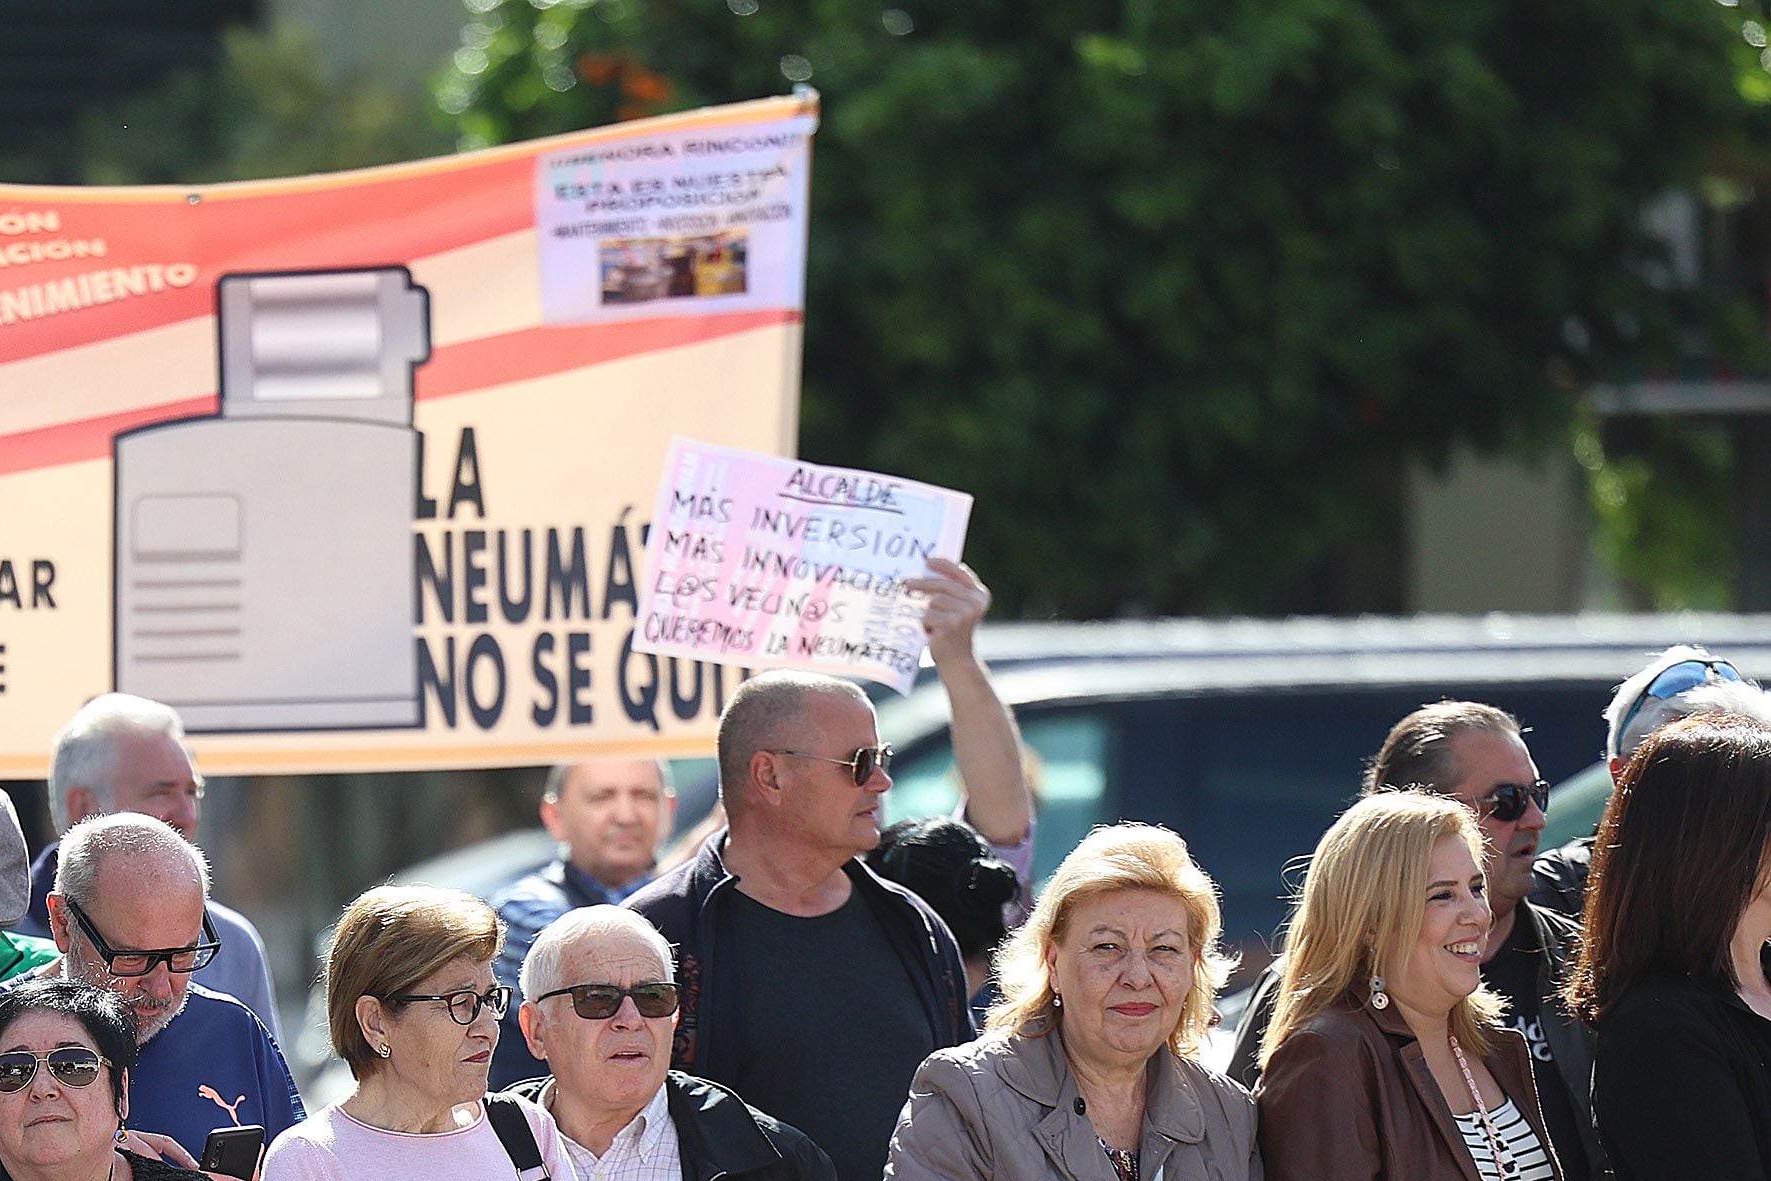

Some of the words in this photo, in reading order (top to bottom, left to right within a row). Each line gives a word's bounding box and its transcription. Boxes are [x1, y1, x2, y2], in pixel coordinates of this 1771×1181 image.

[415, 426, 485, 519] LA
[785, 467, 902, 508] ALCALDE
[415, 505, 651, 625] NEUMÁ
[416, 634, 506, 730] NO
[532, 631, 594, 728] SE
[619, 629, 750, 731] QUI
